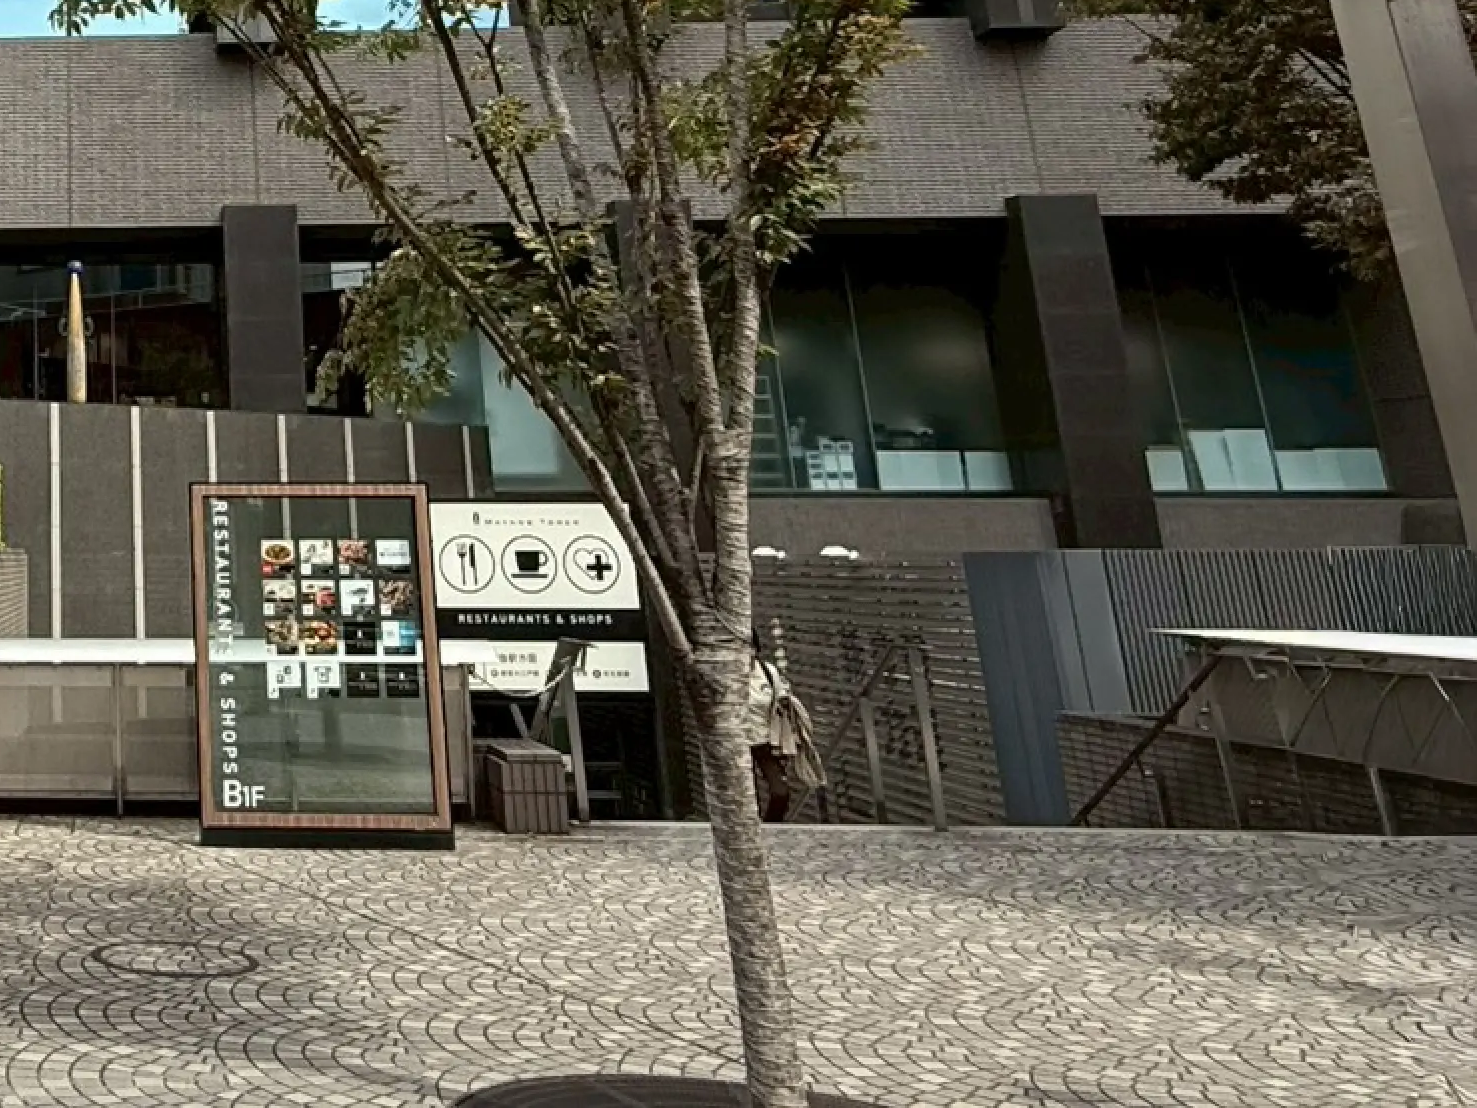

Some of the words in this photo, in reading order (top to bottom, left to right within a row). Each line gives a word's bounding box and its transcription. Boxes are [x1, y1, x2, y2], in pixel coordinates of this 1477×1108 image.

[458, 613, 550, 625] RESTAURANTS
[570, 613, 613, 625] SHOPS
[219, 671, 235, 685] &
[220, 697, 238, 774] SHOPS
[222, 779, 266, 808] B1F
